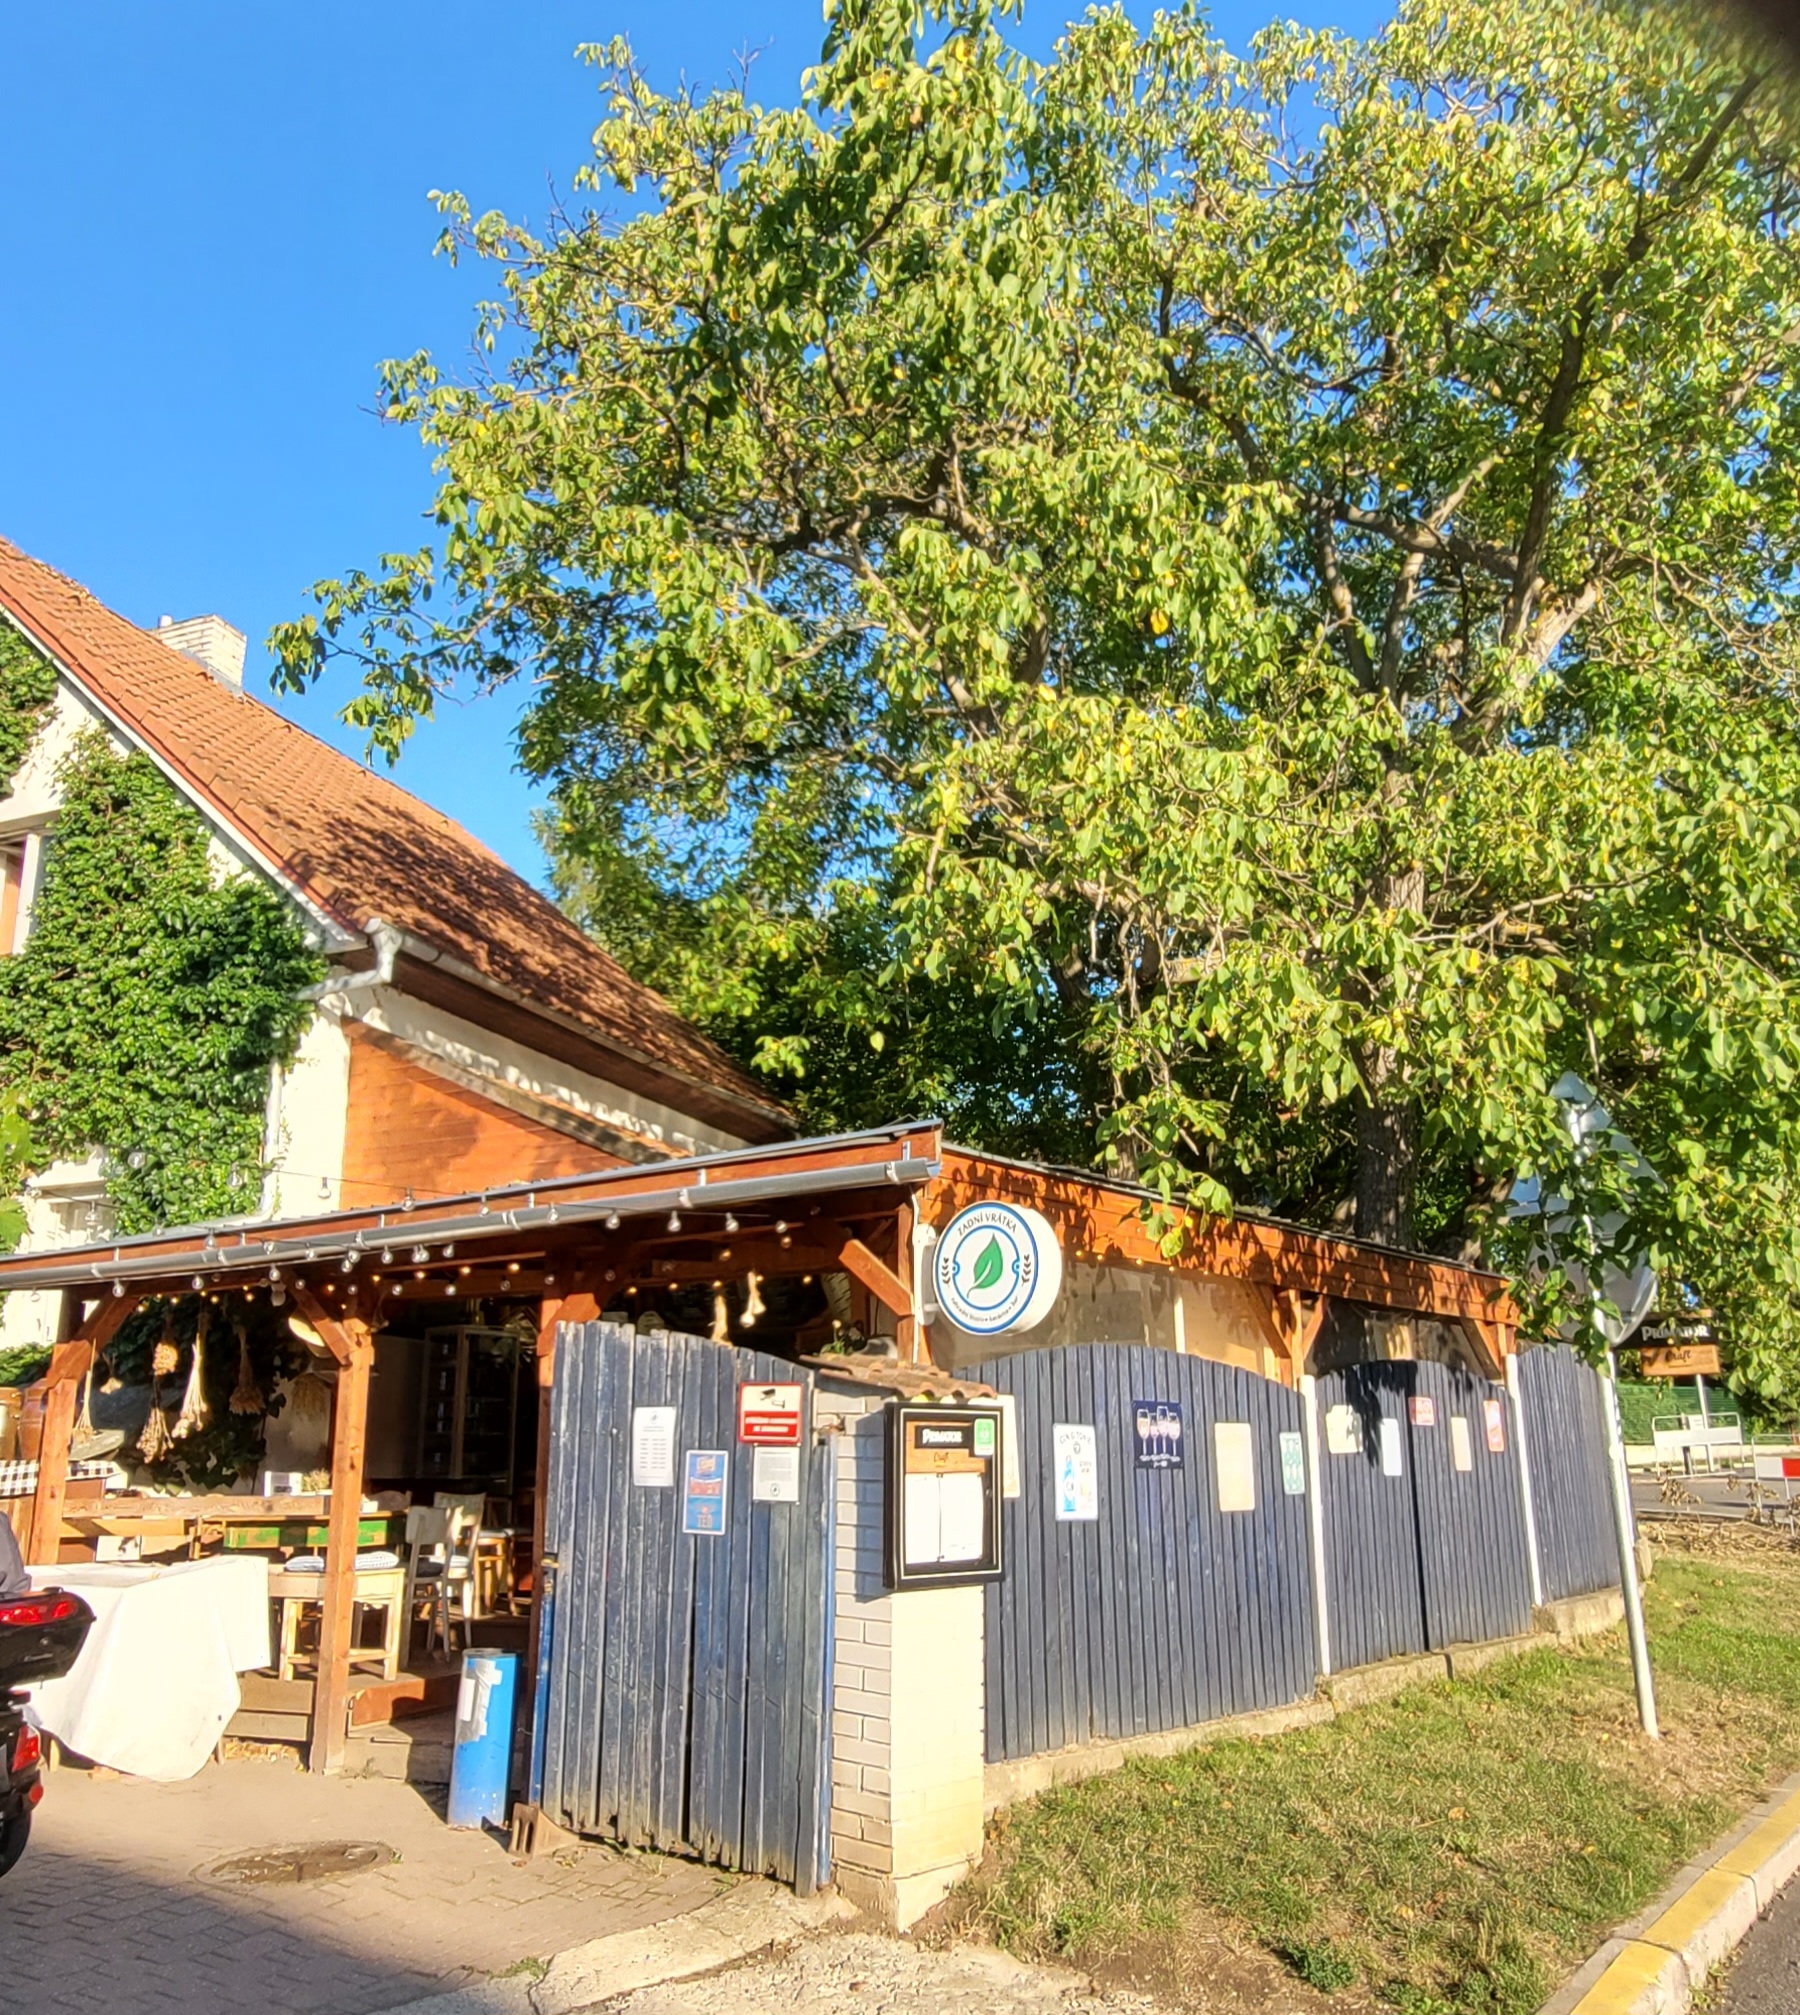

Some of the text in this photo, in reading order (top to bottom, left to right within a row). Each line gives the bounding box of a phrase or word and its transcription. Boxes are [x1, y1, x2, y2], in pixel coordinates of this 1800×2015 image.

[957, 1212, 1017, 1236] ZADNÍ VRÁTKA
[1665, 1349, 1692, 1363] Craft
